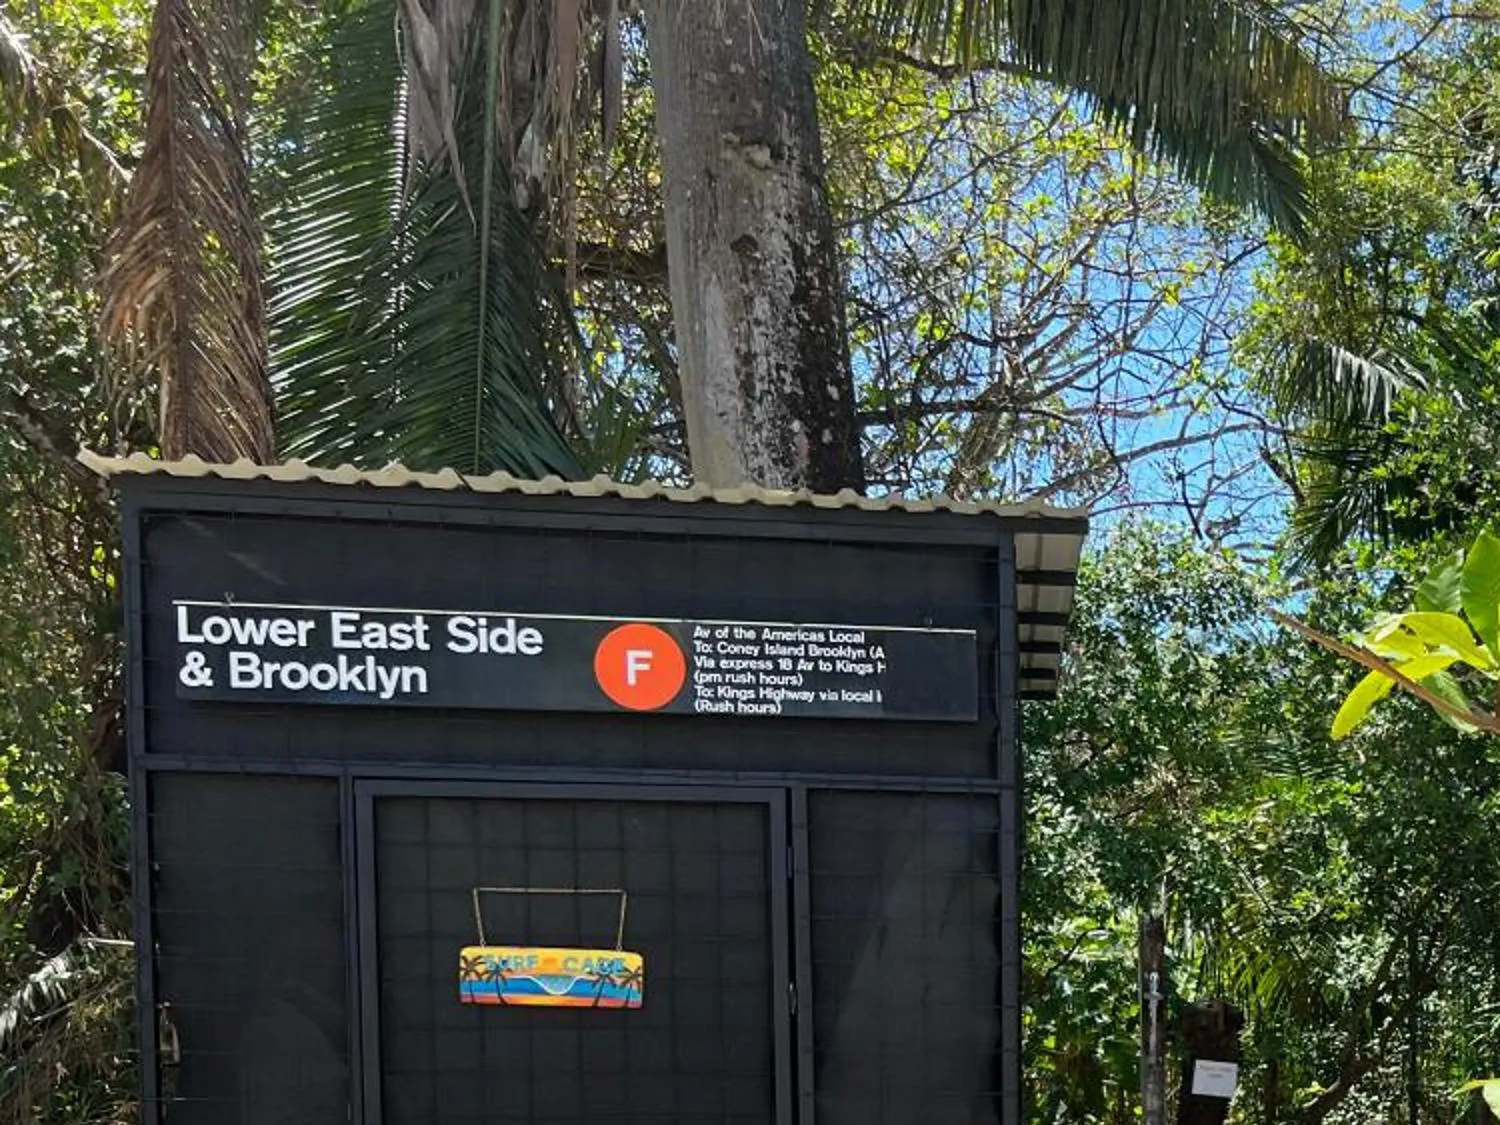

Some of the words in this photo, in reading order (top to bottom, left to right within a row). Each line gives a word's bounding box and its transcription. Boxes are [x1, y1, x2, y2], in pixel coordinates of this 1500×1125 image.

[177, 605, 315, 647] Lower
[331, 612, 430, 650] East
[447, 616, 543, 655] Side
[693, 625, 711, 639] Av
[714, 626, 729, 639] of
[733, 626, 756, 640] the
[761, 627, 825, 643] Americas
[829, 630, 865, 644] Local
[693, 640, 713, 653] To:
[717, 641, 761, 657] Coney
[764, 642, 805, 656] Island
[808, 643, 867, 660] Brooklyn
[178, 651, 213, 687] &
[228, 651, 429, 700] Brooklyn
[626, 649, 653, 687] F
[693, 655, 715, 669] Via
[719, 659, 774, 671] express
[777, 657, 793, 671] 18
[796, 658, 815, 671] Av
[818, 659, 833, 672] to
[835, 660, 874, 676] Kings
[694, 669, 722, 684] (pm
[725, 671, 756, 685] rush
[759, 671, 804, 687] hours)
[694, 684, 715, 698] To:
[717, 685, 756, 700] Kings
[759, 686, 815, 703] Highway
[819, 688, 839, 701] via
[841, 688, 873, 702] local
[694, 699, 735, 713] (Rush
[737, 700, 782, 715] hours)
